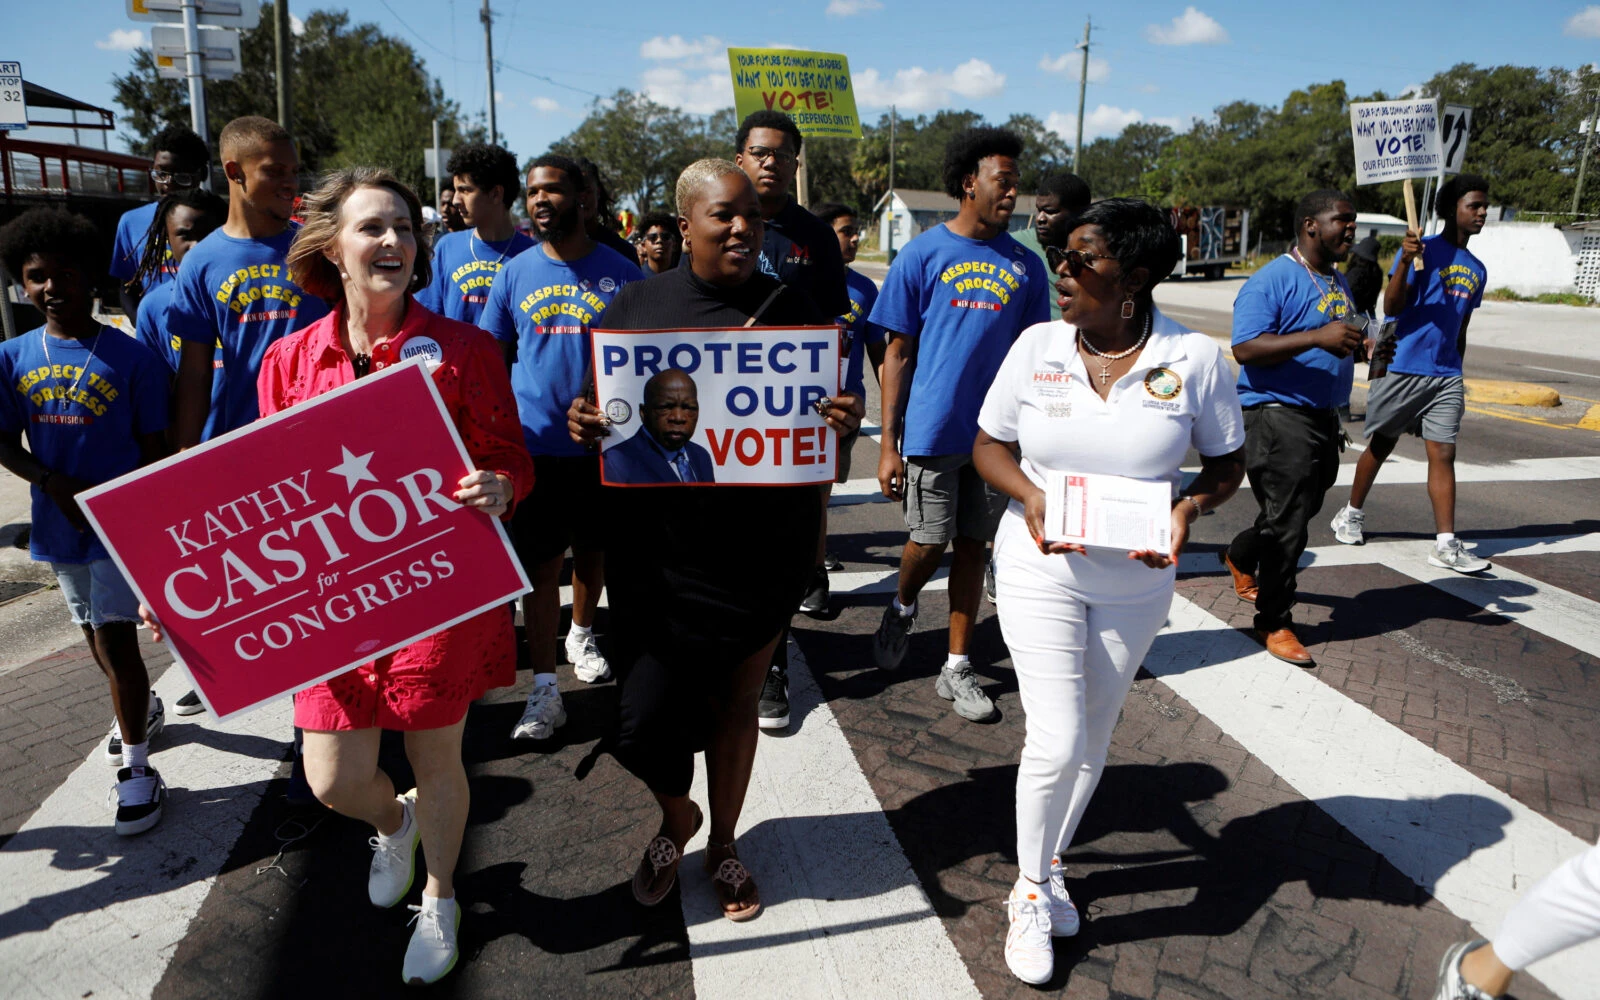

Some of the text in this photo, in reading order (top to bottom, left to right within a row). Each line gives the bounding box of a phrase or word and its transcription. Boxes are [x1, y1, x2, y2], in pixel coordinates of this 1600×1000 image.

[737, 55, 842, 70] YOUR FUTURE COMMUNITY LEADERS
[0, 78, 20, 86] TOP
[736, 69, 848, 92] WANT YOU TO GET OUT AND
[762, 90, 834, 111] VOTE!
[799, 113, 833, 125] DEPENDS
[833, 114, 843, 126] ON
[1357, 120, 1375, 137] WANT
[1379, 119, 1392, 136] YOU
[1393, 119, 1402, 134] TO
[1402, 118, 1414, 133] GET
[1415, 117, 1426, 132] OUT
[1375, 134, 1426, 157] VOTE!
[1362, 160, 1377, 171] OUR
[1377, 156, 1402, 169] FUTURE
[1403, 155, 1425, 166] DEPENDS
[451, 260, 503, 283] RESPECT
[940, 261, 997, 284] RESPECT
[998, 268, 1020, 292] THE
[1439, 264, 1471, 278] RESPECT
[216, 263, 280, 304] RESPECT
[459, 275, 493, 294] PROC
[955, 277, 1010, 304] PROCESS
[229, 284, 302, 313] PROCESS
[520, 284, 578, 313] RESPECT
[957, 299, 968, 308] MEN
[977, 301, 995, 311] VISION
[244, 313, 256, 322] MEN
[267, 310, 290, 320] VISION
[531, 302, 592, 325] PROCESS
[542, 326, 554, 334] MEN
[564, 326, 581, 334] VISION
[403, 343, 438, 359] HARRIS
[602, 341, 829, 376] PROTECT
[16, 364, 119, 402] RESPECT THE
[1033, 372, 1072, 383] HART
[31, 385, 107, 416] PROCESS
[725, 385, 827, 417] OUR
[60, 415, 85, 425] VISION
[704, 425, 827, 467] VOTE!
[165, 469, 317, 557] KATHY
[163, 467, 465, 620] CASTOR
[317, 570, 341, 596] for
[234, 550, 456, 661] CONGRESS
